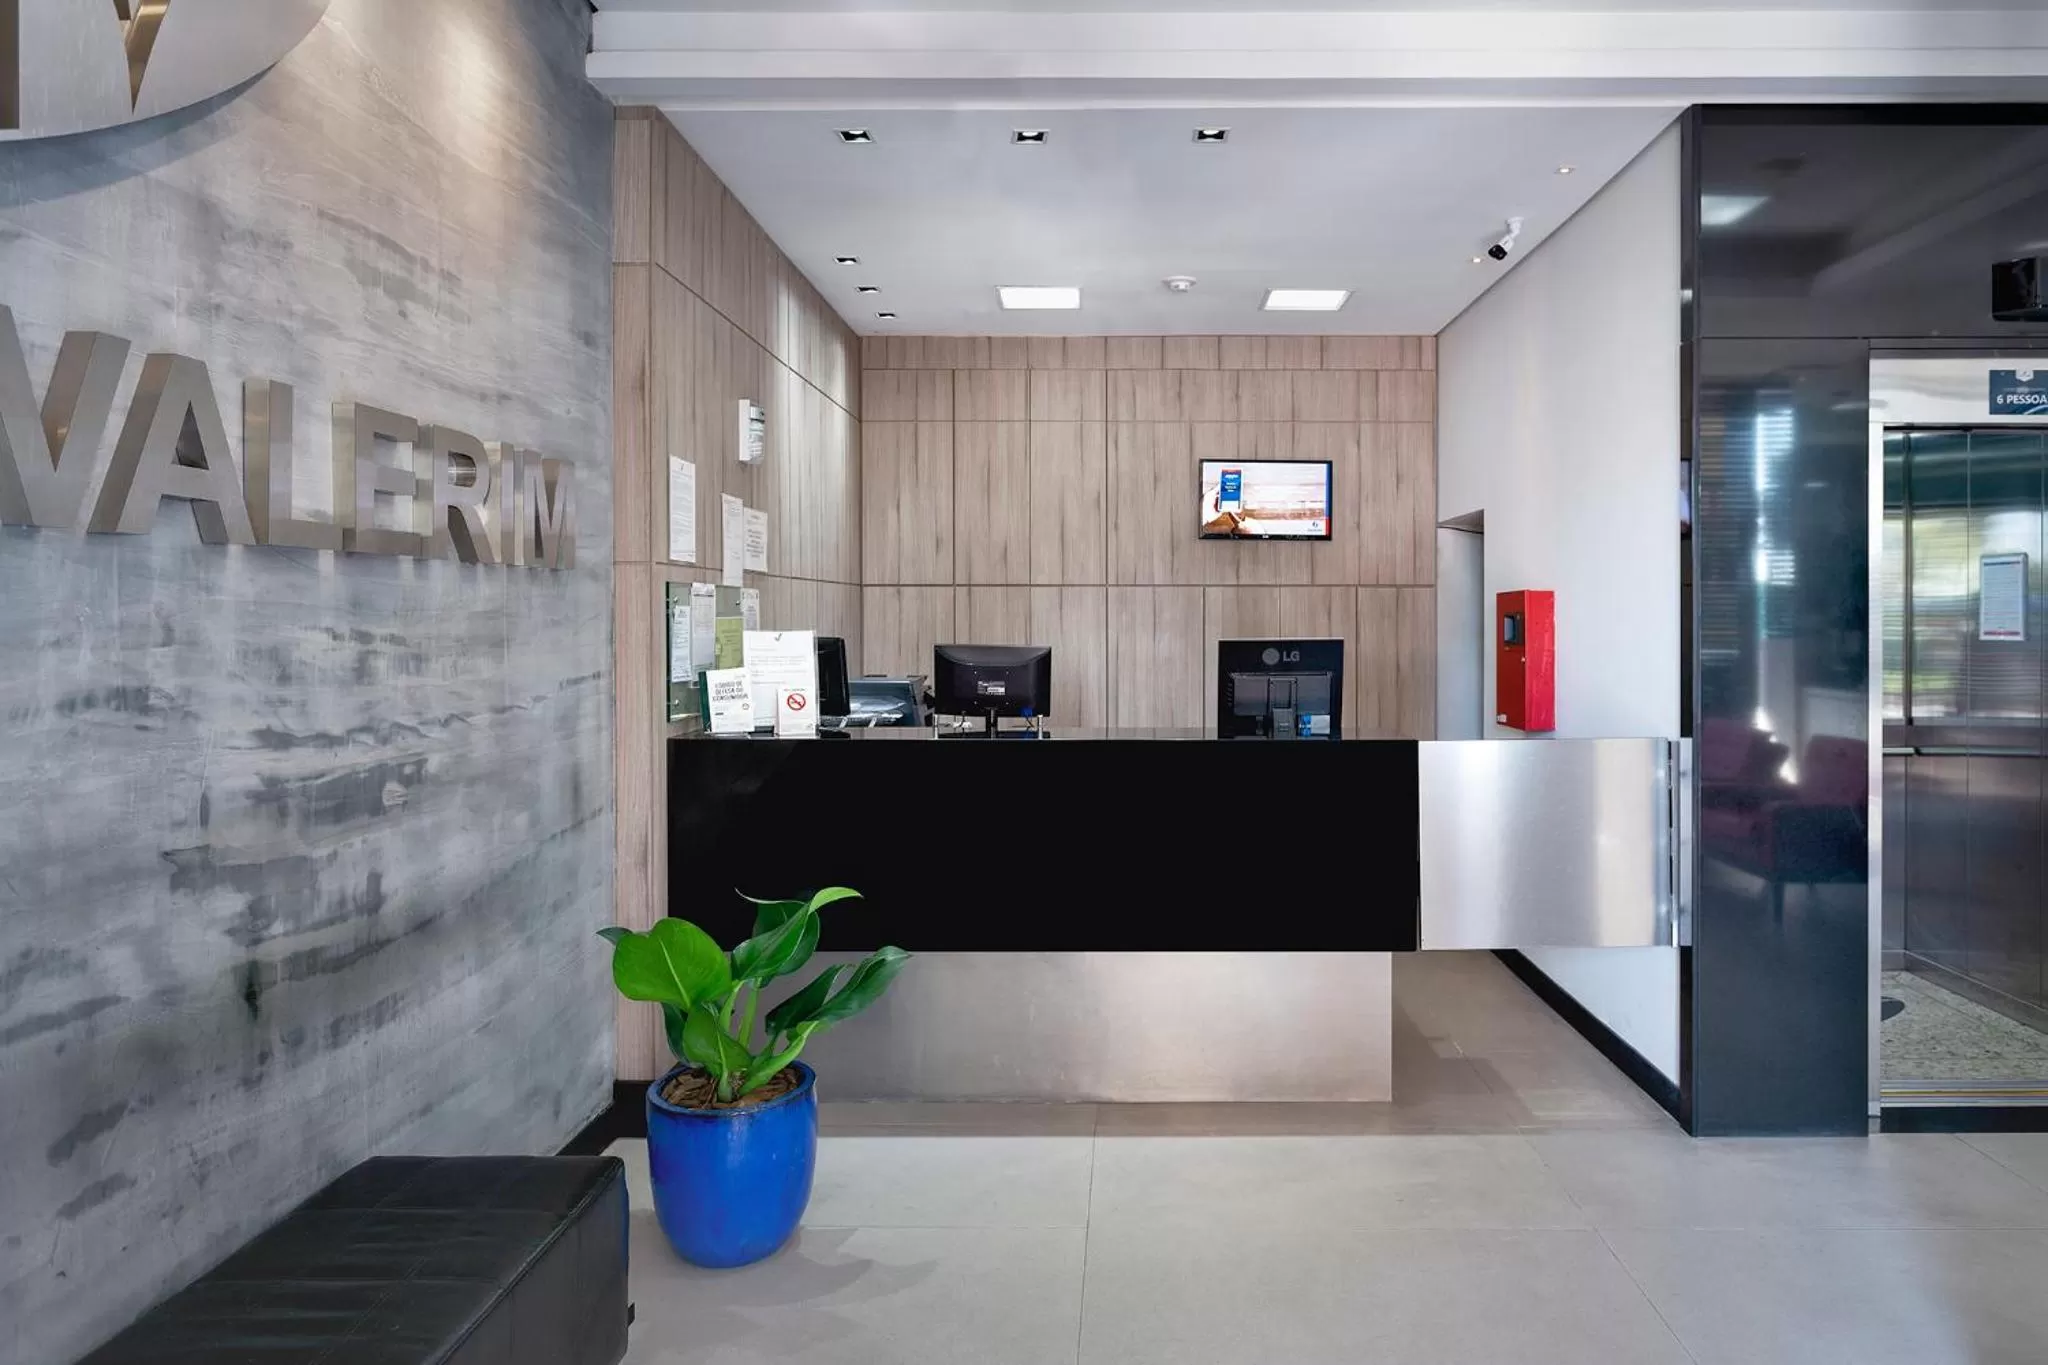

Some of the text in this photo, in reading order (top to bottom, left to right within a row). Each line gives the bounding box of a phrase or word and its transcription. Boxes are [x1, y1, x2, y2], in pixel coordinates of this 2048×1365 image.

[1996, 394, 2004, 405] 6
[0, 303, 576, 570] VALERIM
[1282, 651, 1301, 662] LG
